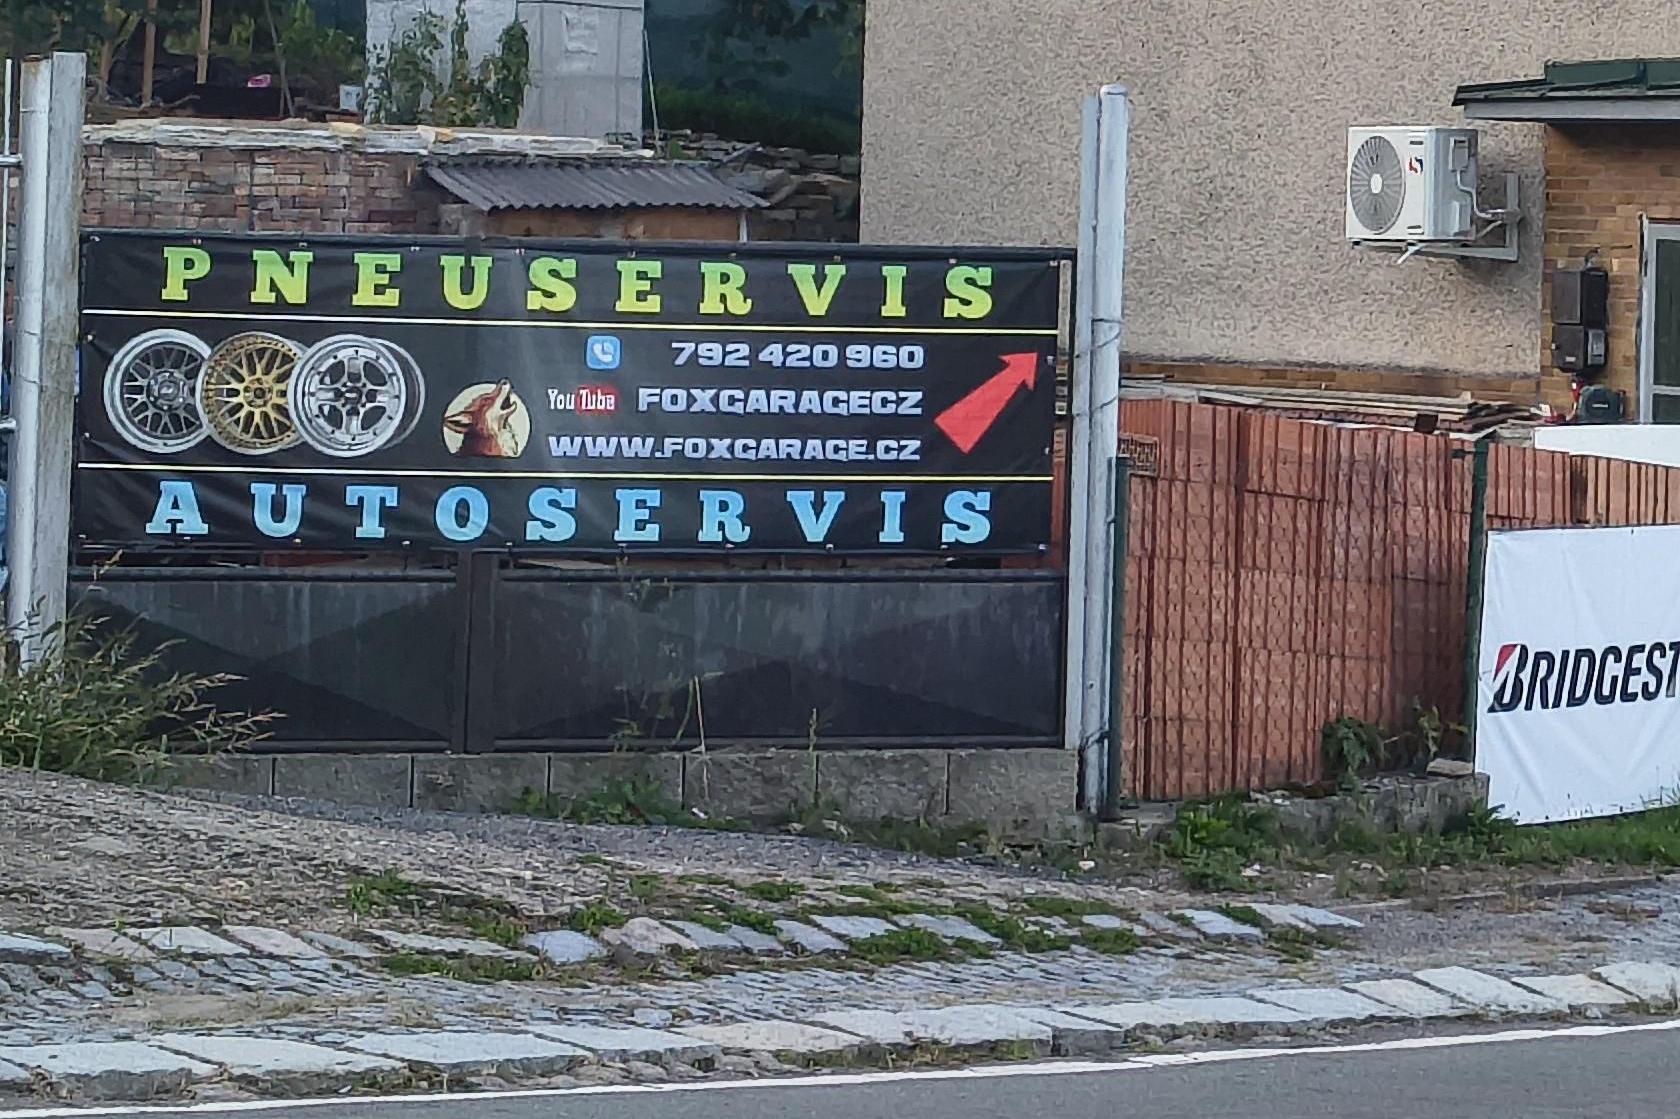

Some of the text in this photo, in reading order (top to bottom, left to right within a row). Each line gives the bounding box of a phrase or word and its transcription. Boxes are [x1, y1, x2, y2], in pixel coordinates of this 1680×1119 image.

[160, 246, 994, 319] PNEUSERVIS
[671, 342, 924, 369] 792 420 960
[638, 388, 923, 416] FOXGARAGECZ
[549, 436, 921, 462] WWW.FOXGARAGE.CZ
[145, 481, 992, 545] AUTOSERVIS
